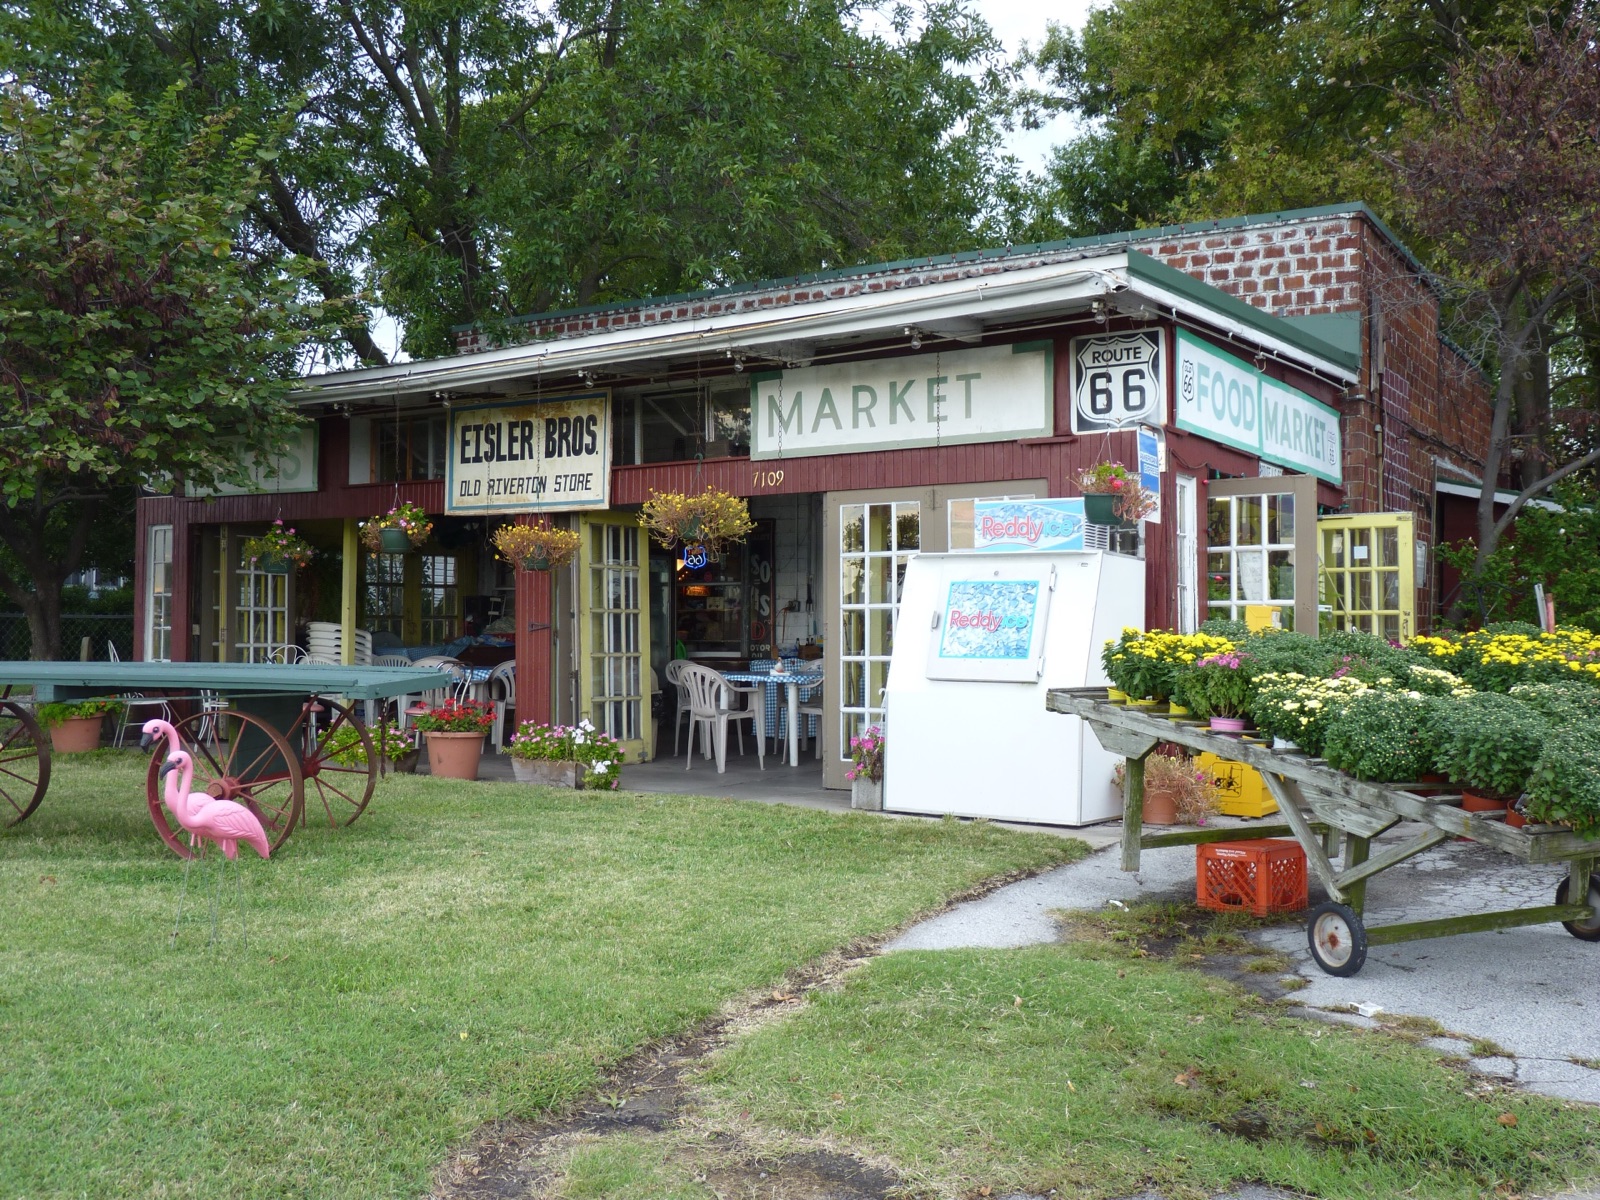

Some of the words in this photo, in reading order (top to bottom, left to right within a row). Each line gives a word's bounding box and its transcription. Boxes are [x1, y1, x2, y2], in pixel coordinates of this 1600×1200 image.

[1092, 347, 1142, 364] ROUTE
[1090, 368, 1145, 415] 66
[1183, 374, 1193, 394] 66
[767, 373, 982, 438] MARKET
[1197, 362, 1256, 432] FOOD
[1264, 397, 1327, 462] MARKET
[460, 420, 534, 464] EISLER
[545, 414, 599, 459] BROS.
[460, 480, 482, 497] OLD
[487, 476, 547, 496] RIVERTON
[553, 473, 593, 492] STORE
[753, 470, 784, 488] 7109
[981, 515, 1044, 544] Reddy
[950, 610, 1003, 633] Reddy
[750, 643, 771, 652] OTOR
